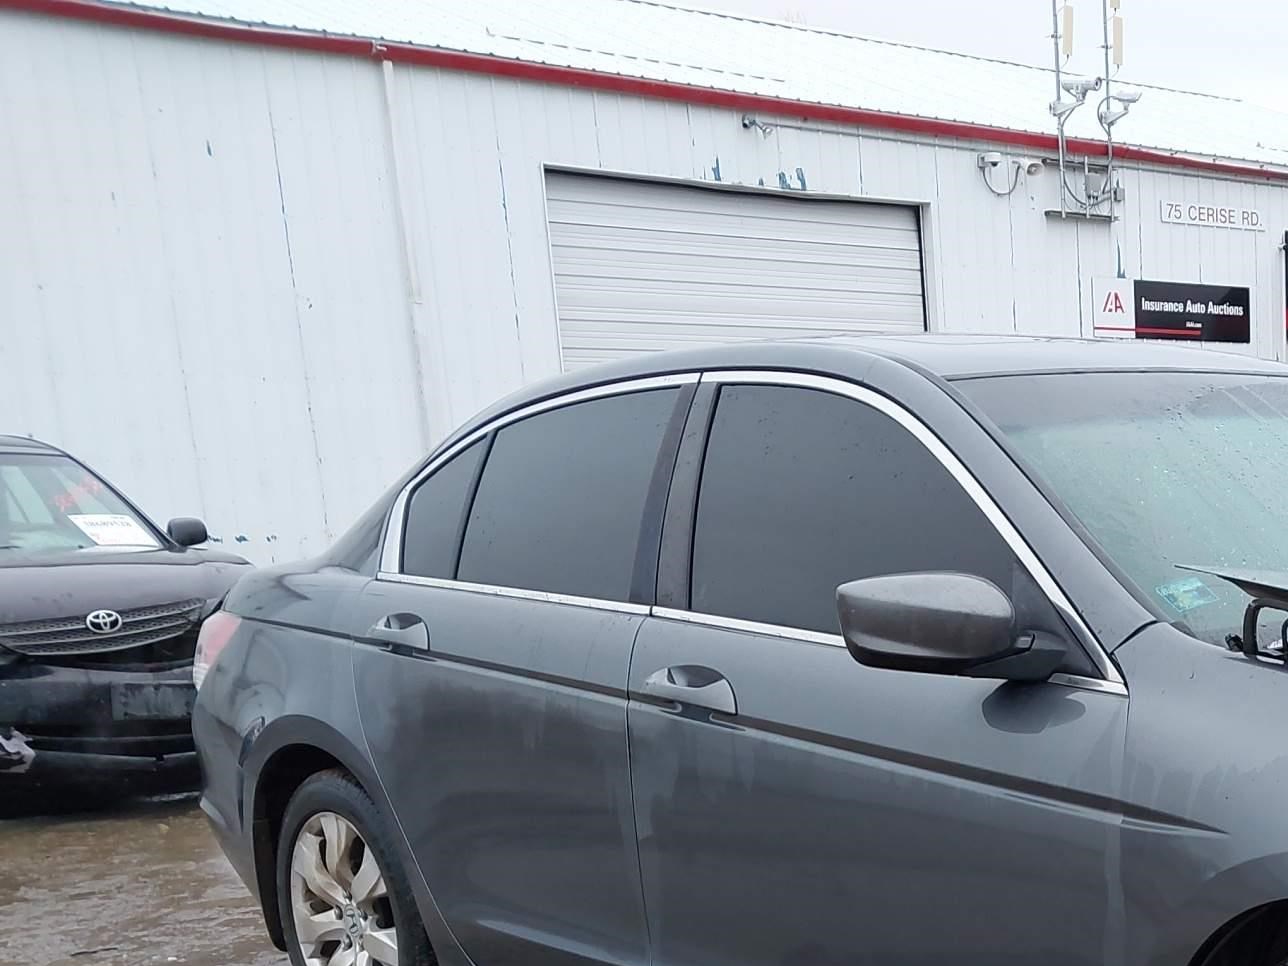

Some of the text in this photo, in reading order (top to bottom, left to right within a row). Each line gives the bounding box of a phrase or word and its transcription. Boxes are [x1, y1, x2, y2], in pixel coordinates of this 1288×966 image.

[1166, 202, 1263, 227] 75 CERISE RD.
[1141, 296, 1244, 317] Insurance Auto Auctions
